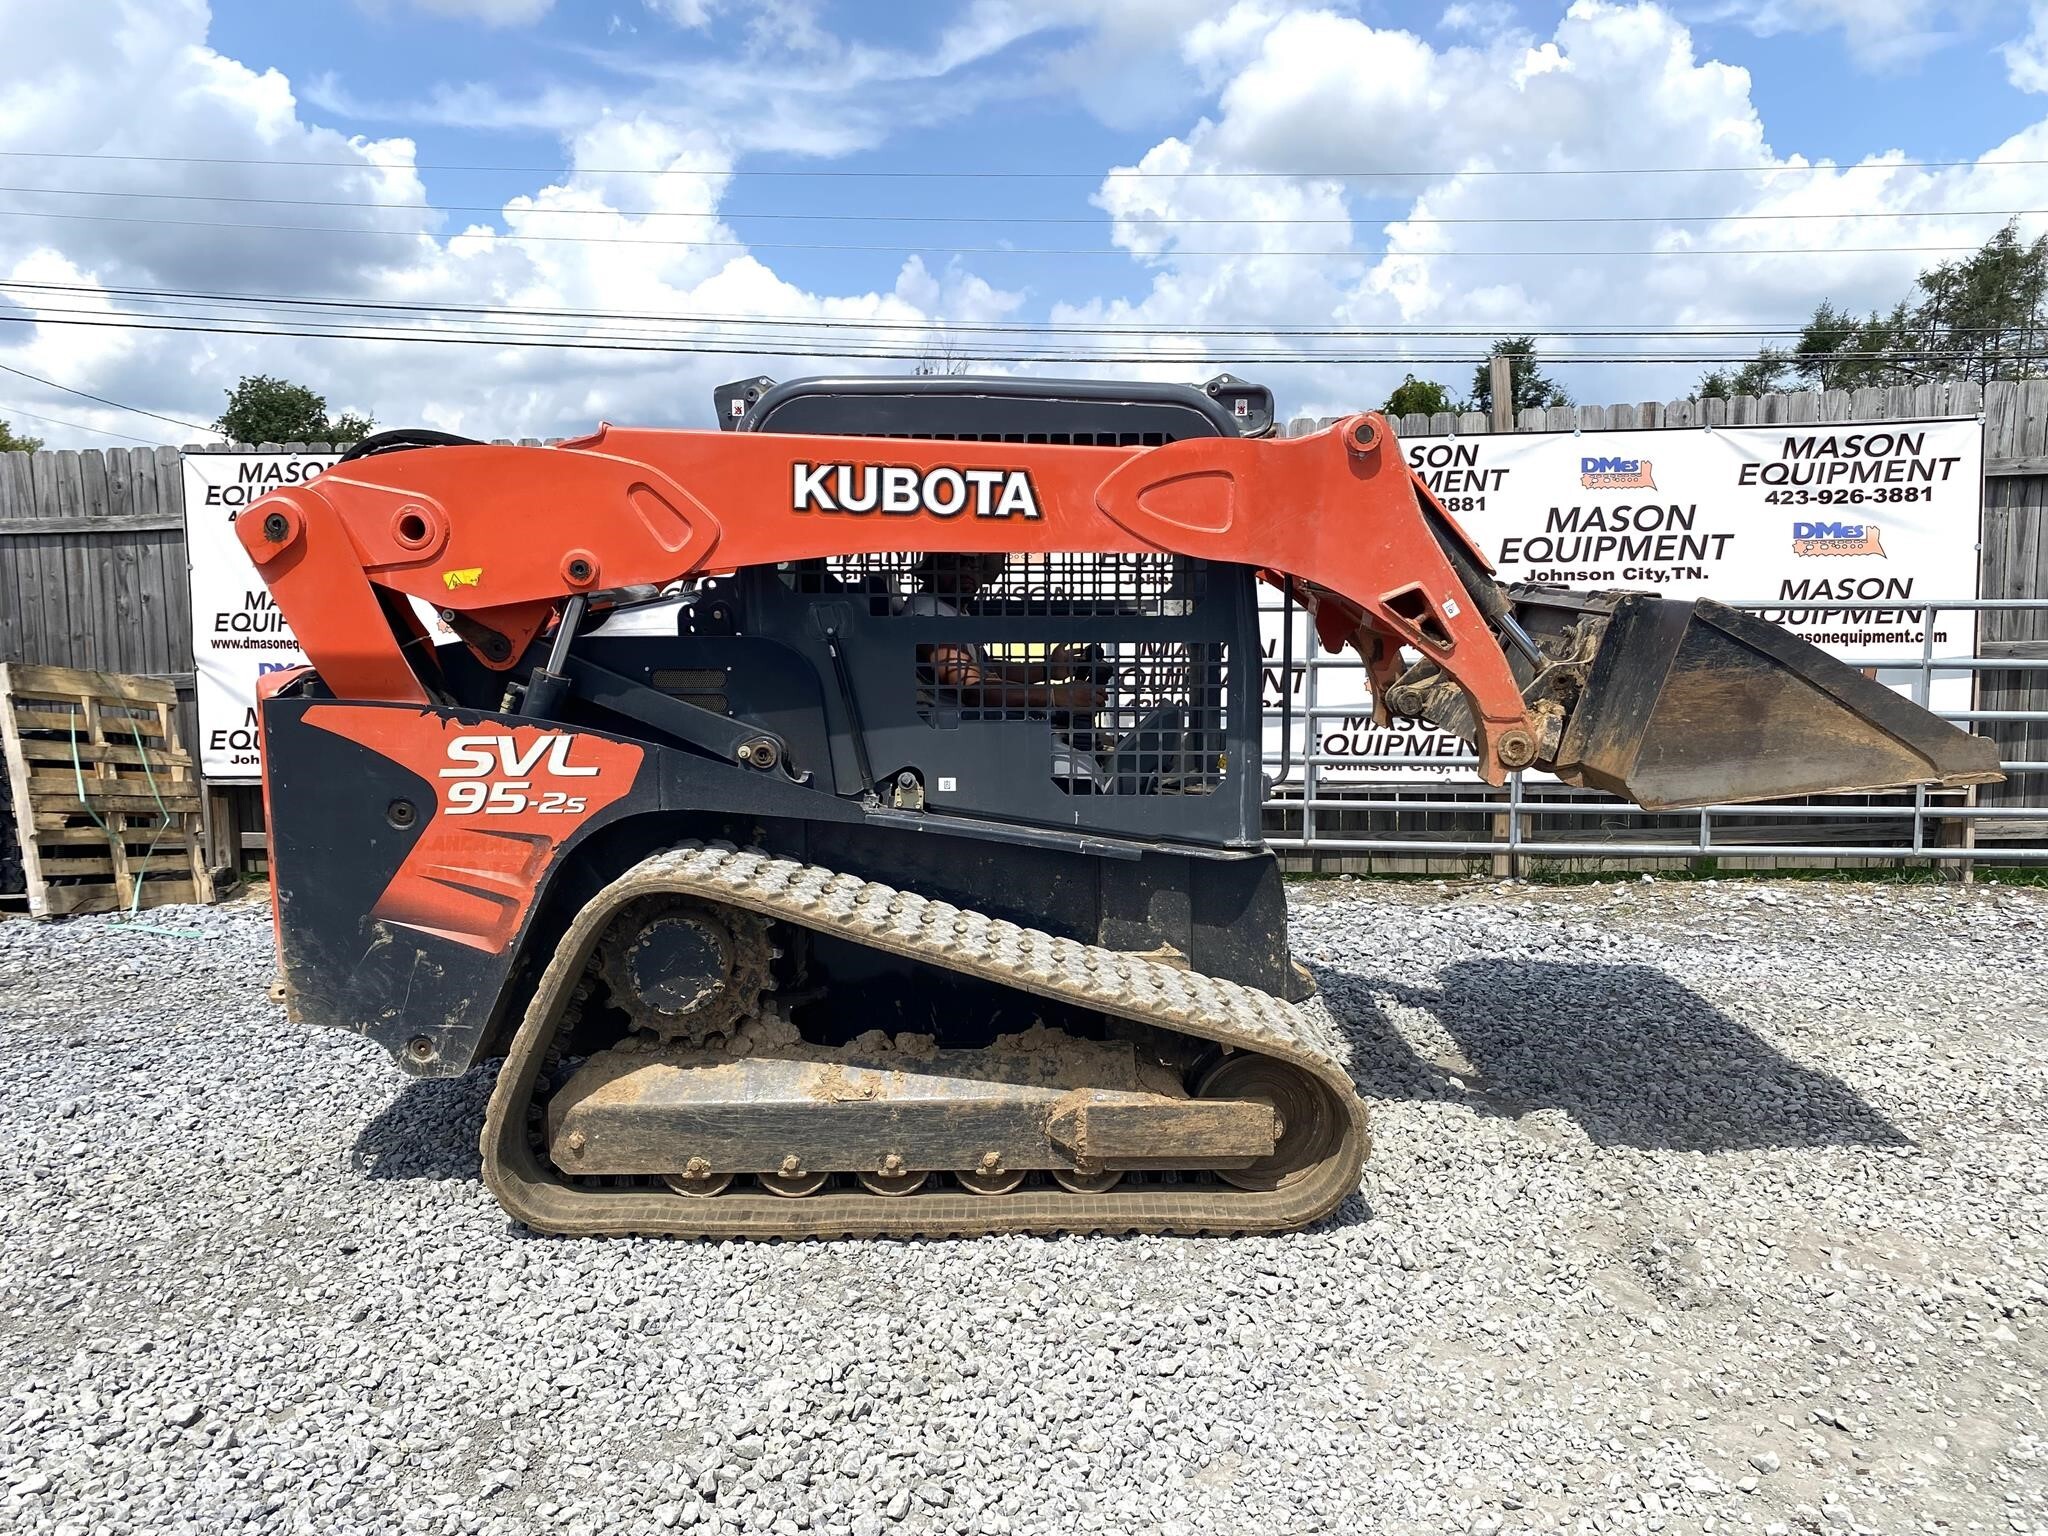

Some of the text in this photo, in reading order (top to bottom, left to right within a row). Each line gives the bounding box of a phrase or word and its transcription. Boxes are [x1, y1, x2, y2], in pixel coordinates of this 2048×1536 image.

[1408, 444, 1479, 469] SON
[1782, 433, 1926, 459] MASON
[238, 462, 338, 483] MASO
[1738, 457, 1961, 486] EQUIPMENT
[792, 463, 1040, 518] KUBOTA
[1765, 486, 1932, 505] 423-926-3881
[1546, 504, 1697, 533] MASON
[1498, 534, 1735, 563] EQUIPMENT
[1523, 569, 1615, 582] Johnson
[1779, 578, 1914, 601] MASON
[438, 735, 600, 778] SVL
